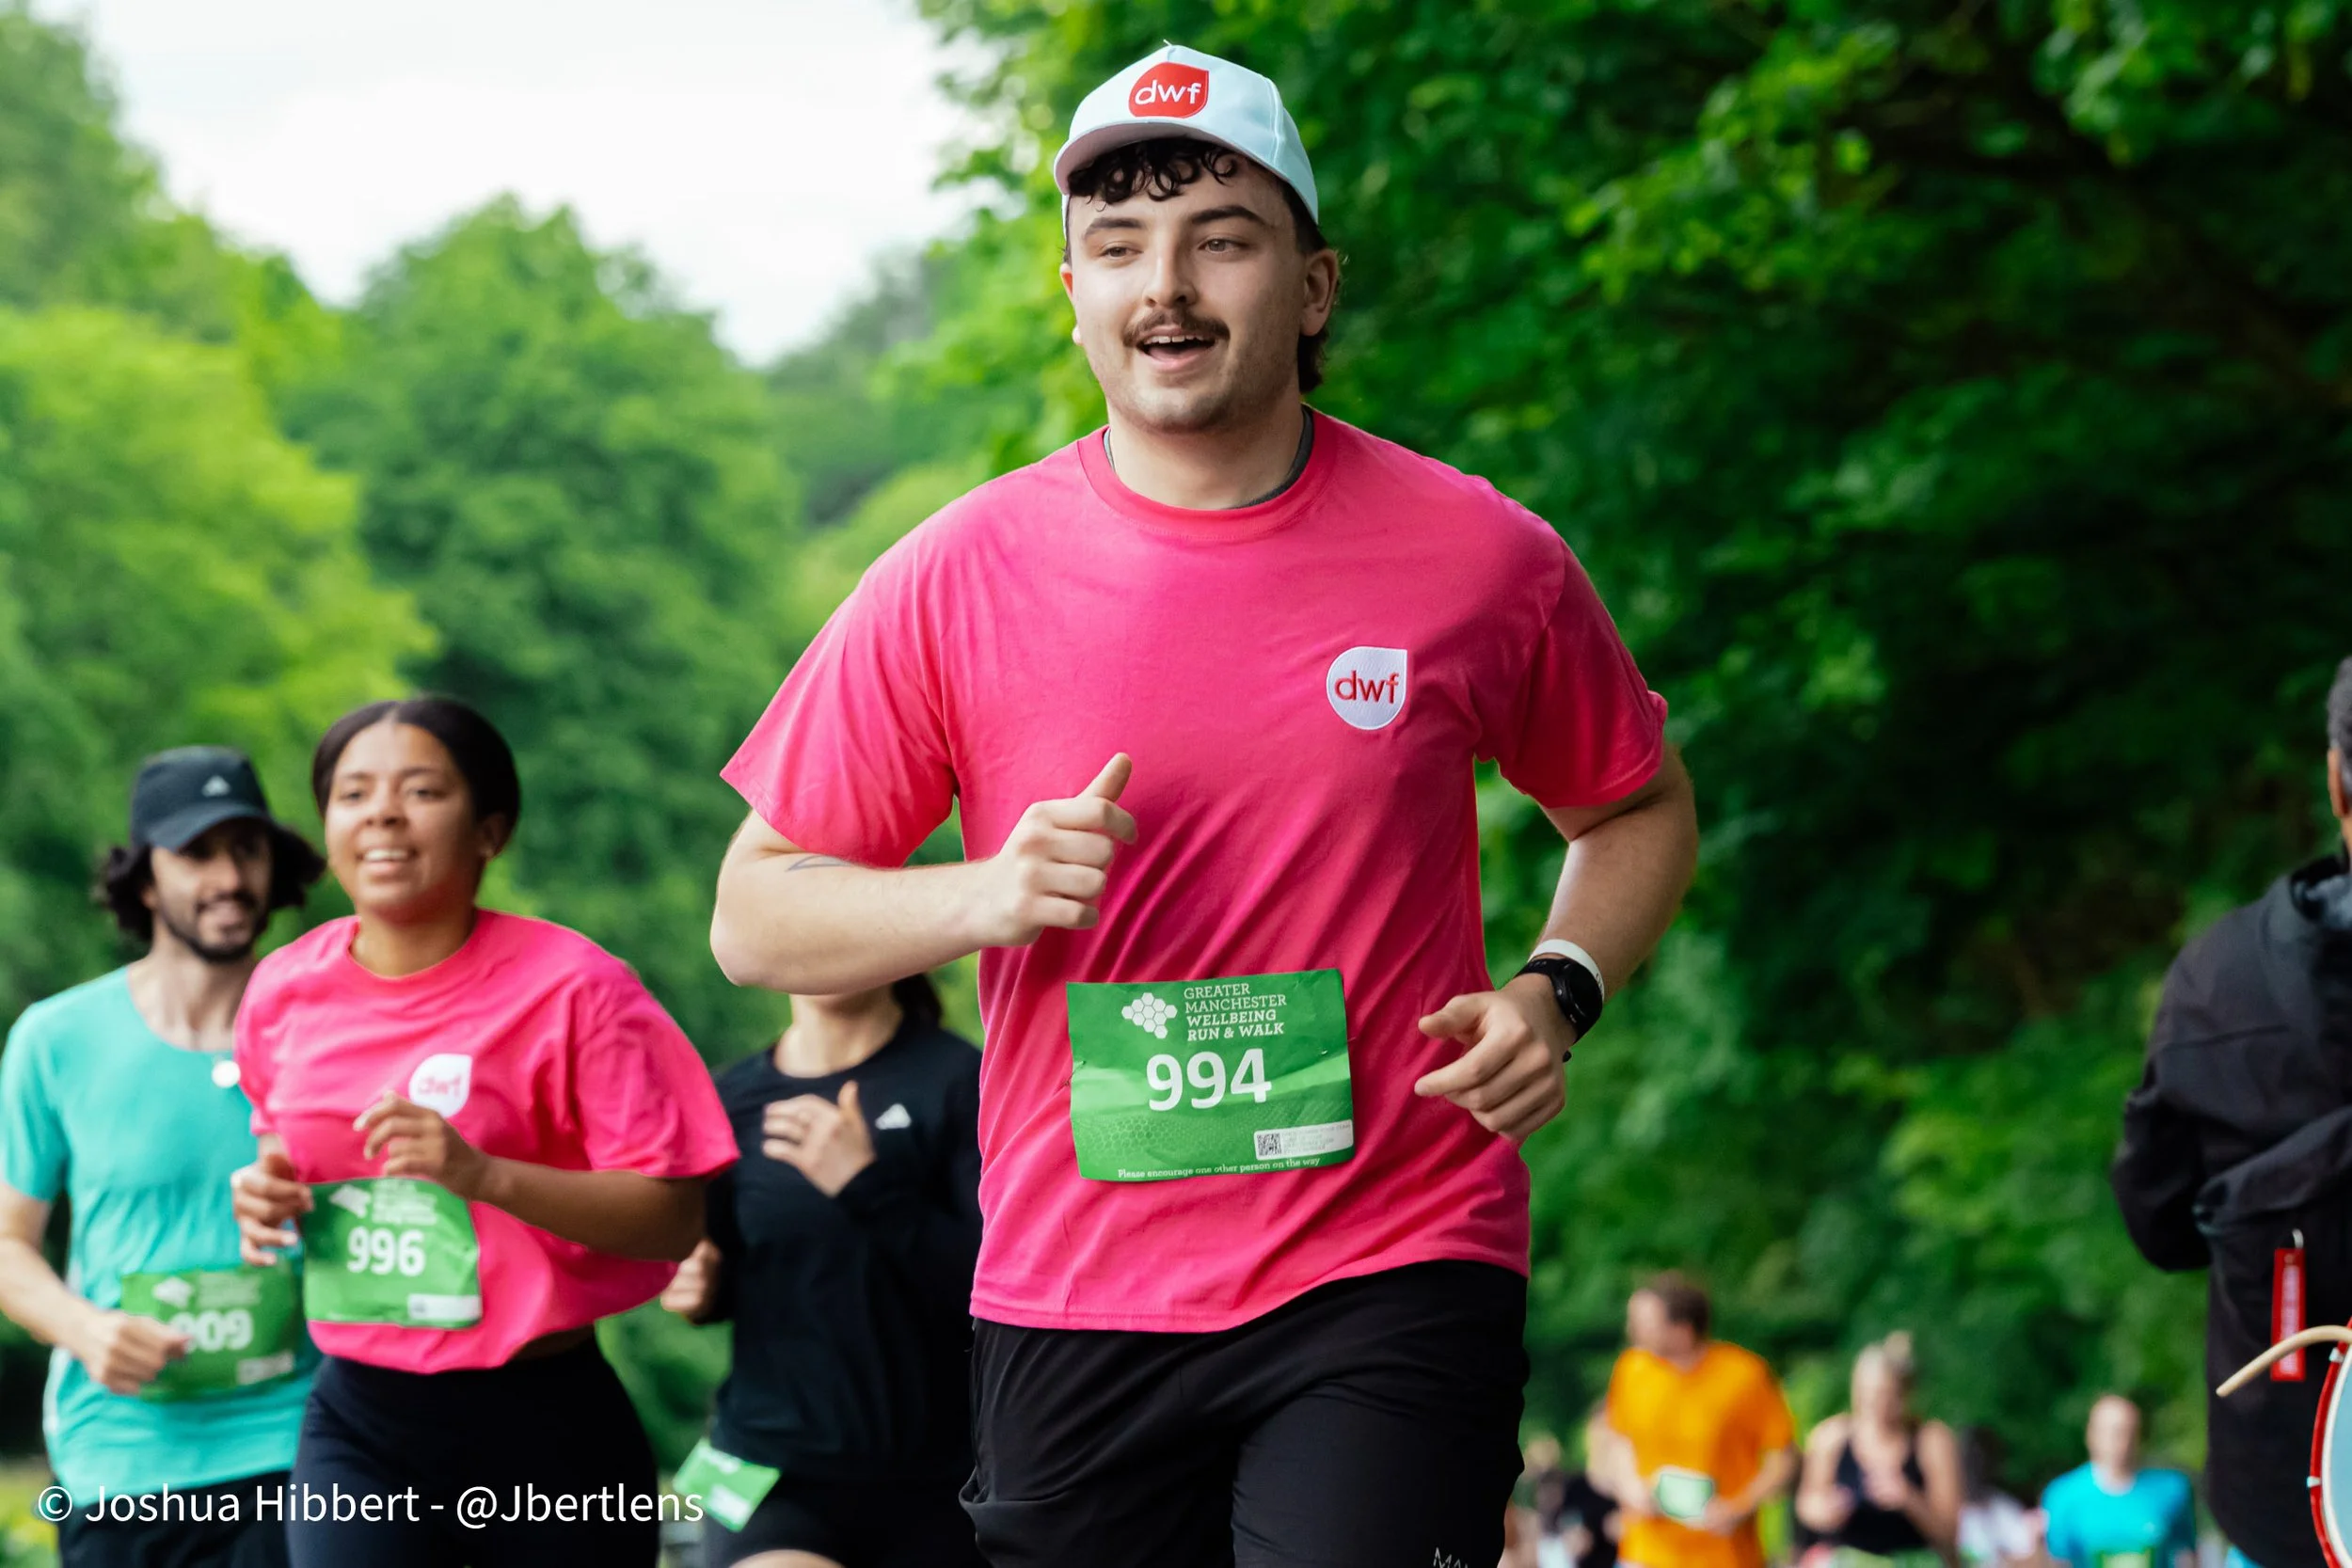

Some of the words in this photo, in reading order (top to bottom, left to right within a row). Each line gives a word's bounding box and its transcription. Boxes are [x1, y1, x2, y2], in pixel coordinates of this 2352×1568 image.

[1135, 79, 1202, 105] dwf
[1334, 670, 1400, 705] dwf
[1184, 983, 1251, 999] GREATER
[1184, 994, 1287, 1014] MANCHESTER
[1186, 1008, 1277, 1027] WELLBEING
[1187, 1027, 1220, 1041] RUN
[1224, 1026, 1234, 1039] &
[1238, 1022, 1285, 1037] WALK
[1146, 1048, 1272, 1111] 994
[1118, 1168, 1146, 1179] Please
[1147, 1167, 1194, 1178] encourage
[1195, 1166, 1212, 1175] one
[1214, 1164, 1238, 1173] other
[1240, 1163, 1271, 1174] person
[1272, 1161, 1284, 1169] on
[1286, 1158, 1301, 1167] the
[1302, 1157, 1321, 1166] way
[347, 1226, 426, 1277] 996
